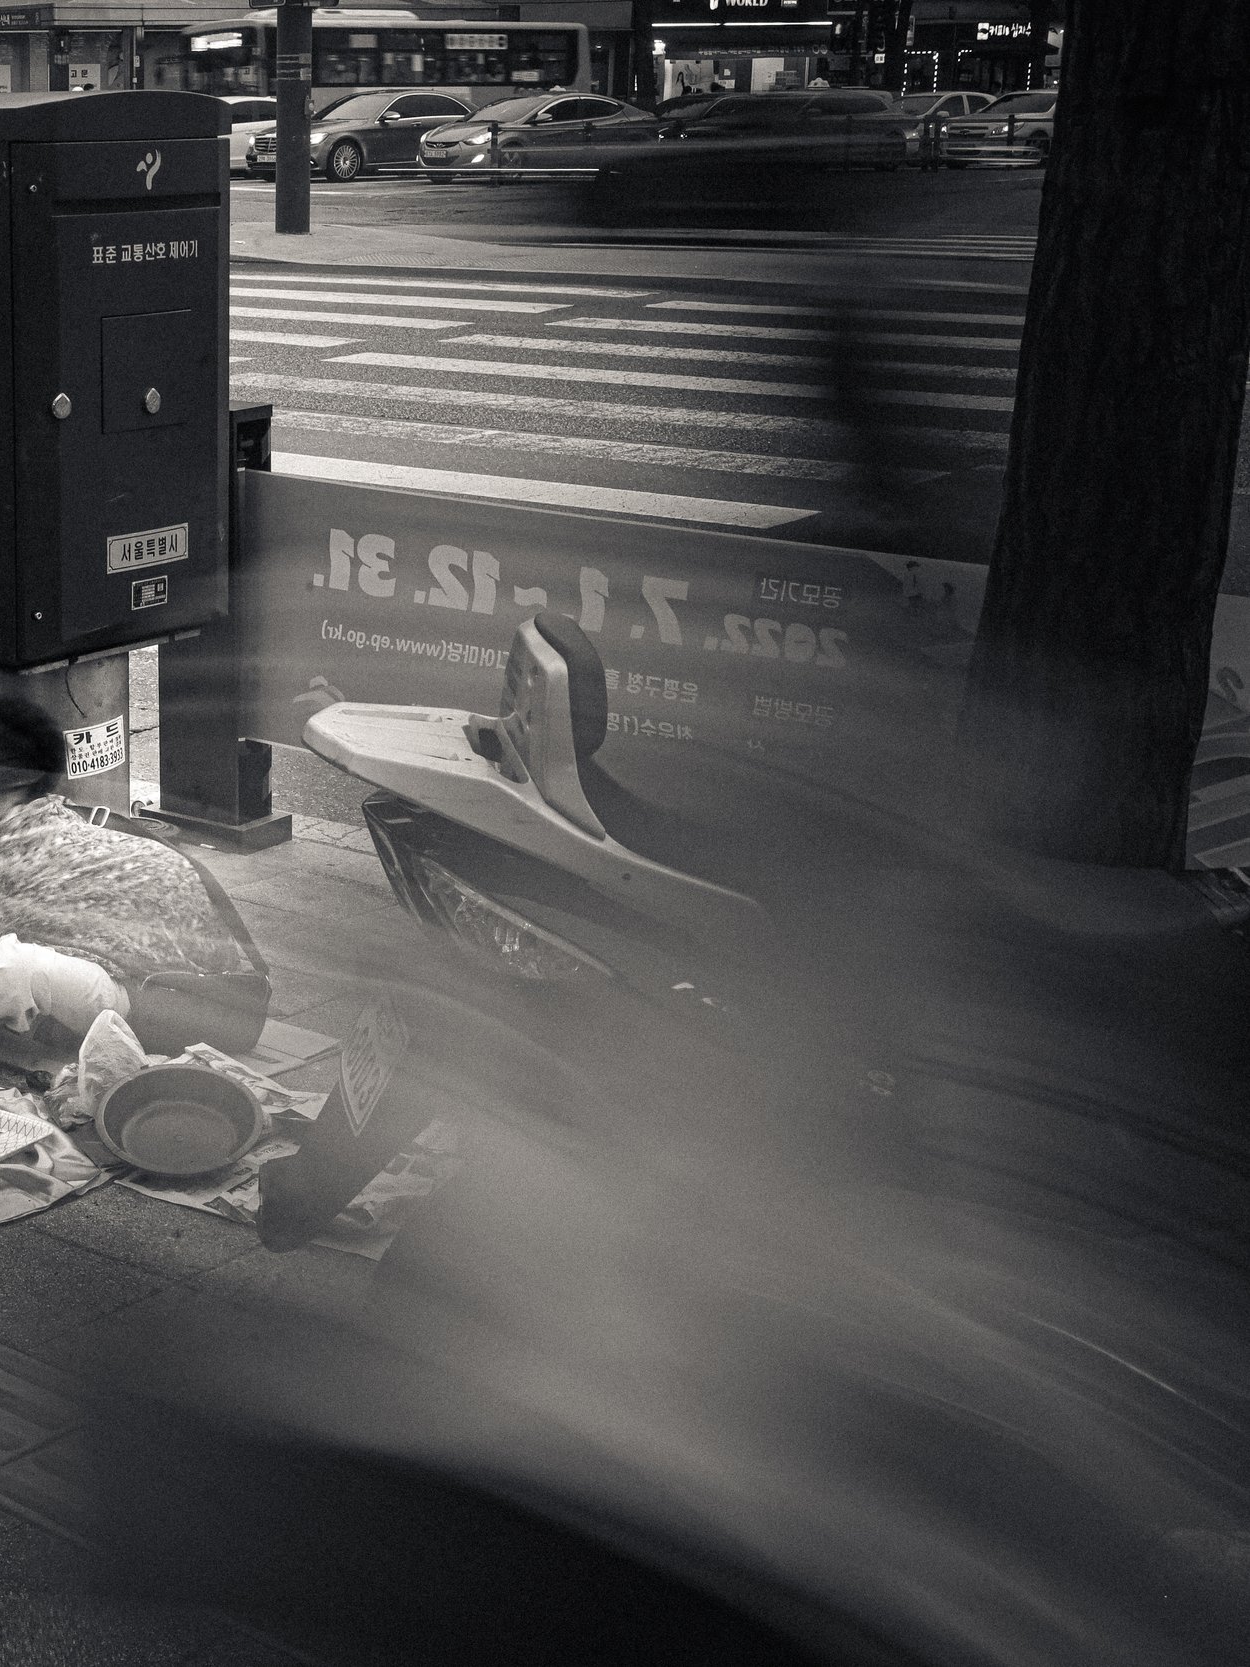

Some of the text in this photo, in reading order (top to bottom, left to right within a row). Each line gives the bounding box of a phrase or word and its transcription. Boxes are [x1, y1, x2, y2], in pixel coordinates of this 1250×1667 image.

[92, 245, 117, 264] 표준
[169, 240, 198, 259] 제어기
[121, 533, 178, 562] 서울특별시
